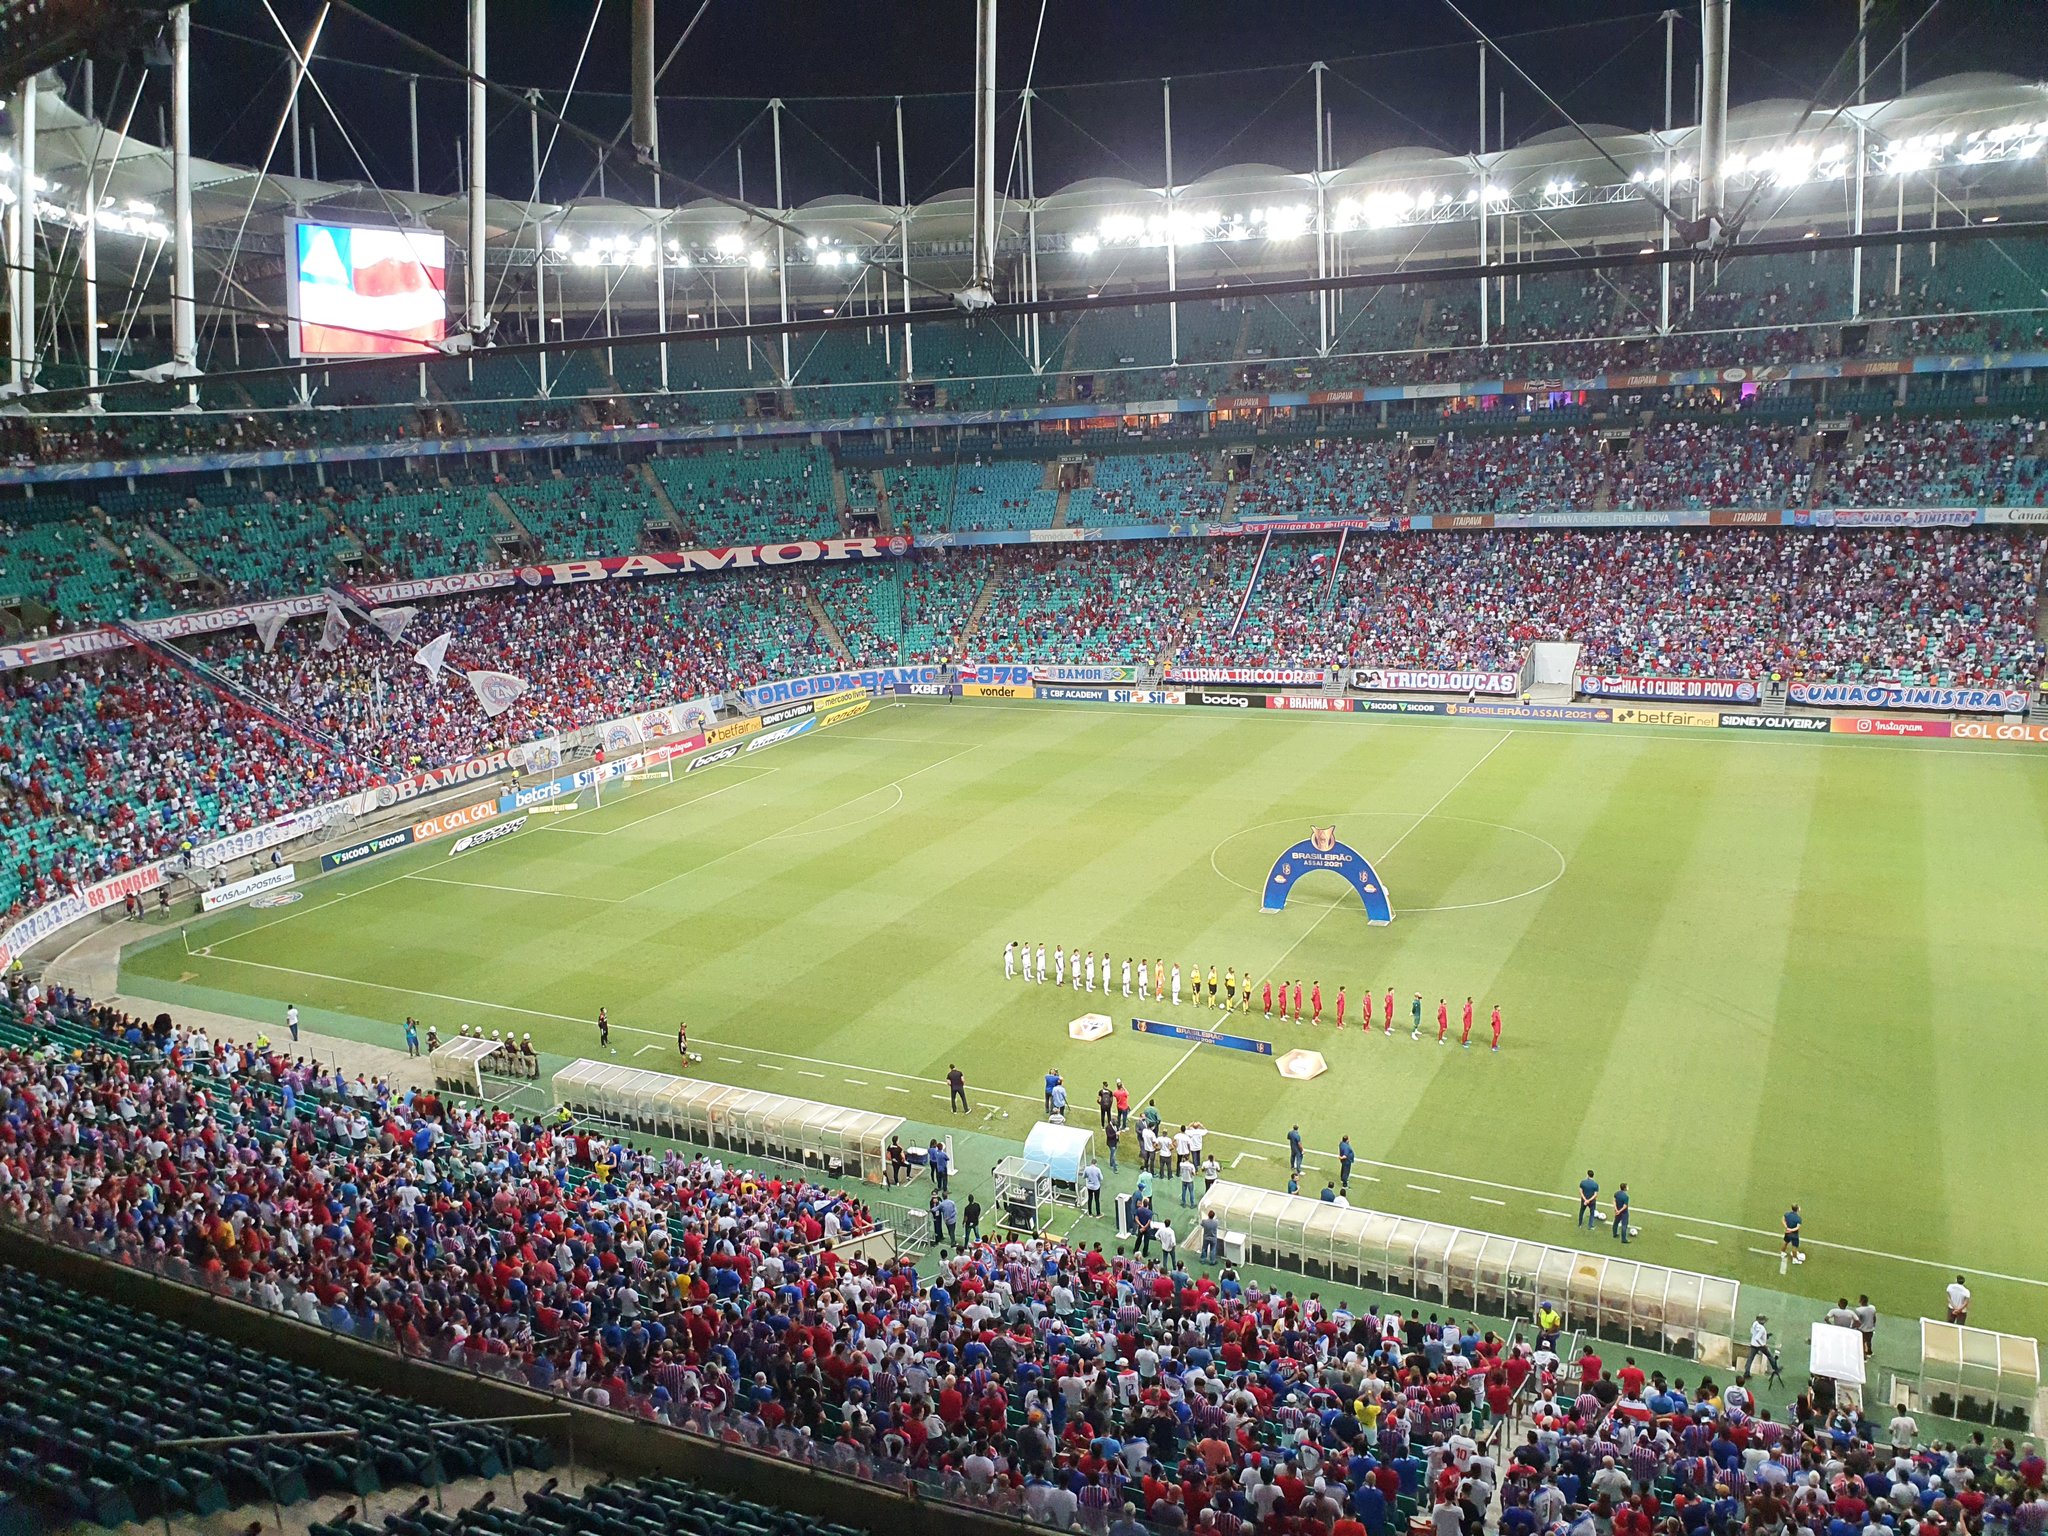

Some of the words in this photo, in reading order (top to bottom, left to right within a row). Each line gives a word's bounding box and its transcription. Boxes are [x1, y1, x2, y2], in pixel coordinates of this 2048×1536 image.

[1452, 516, 1483, 526] ITAIPAVA
[1538, 516, 1579, 524] ITAIPAVA
[1732, 512, 1767, 523] ITAIPAVA
[548, 537, 882, 585] BAMOR
[1058, 669, 1099, 679] BAMOR
[1183, 669, 1230, 683] TURMA
[1235, 669, 1305, 684] TRICOLOR
[1386, 671, 1515, 692] TRICOLOUCAS
[1640, 678, 1646, 694] É
[1647, 681, 1653, 694] O
[1656, 681, 1684, 695] CLUBE
[1688, 683, 1701, 697] DO
[1706, 683, 1733, 698] POVO
[909, 685, 945, 695] 1XBET
[980, 687, 1014, 697] vonder
[1050, 690, 1063, 698] CBF
[1065, 690, 1102, 699] ACADEMY
[824, 692, 851, 707] mercado
[1202, 694, 1249, 707] bodog
[1290, 698, 1328, 710] BRAHMA
[1370, 703, 1397, 711] SICOOB
[1406, 704, 1434, 712] SICOOB
[1459, 706, 1530, 717] BRASILEIRÃO
[1565, 711, 1592, 719] 2021
[763, 711, 786, 726] SIDNEY
[1722, 716, 1763, 727] SIDNEY
[1875, 721, 1924, 734] Instagram
[1954, 724, 1991, 738] GOL
[1997, 726, 2034, 740] GOL
[398, 753, 508, 800] BAMOR
[515, 780, 561, 808] betcris
[414, 822, 442, 840] GOL
[443, 812, 469, 833] GOL
[470, 804, 497, 823] GOL
[378, 834, 405, 850] SICOOB
[341, 846, 369, 862] SICOOB
[1292, 852, 1352, 862] BRASILEIRÃO
[88, 890, 106, 907] 88
[106, 867, 160, 899] TAMBÉM
[216, 888, 241, 903] CASA
[1441, 1418, 1453, 1428] 16
[1456, 1447, 1467, 1461] 10
